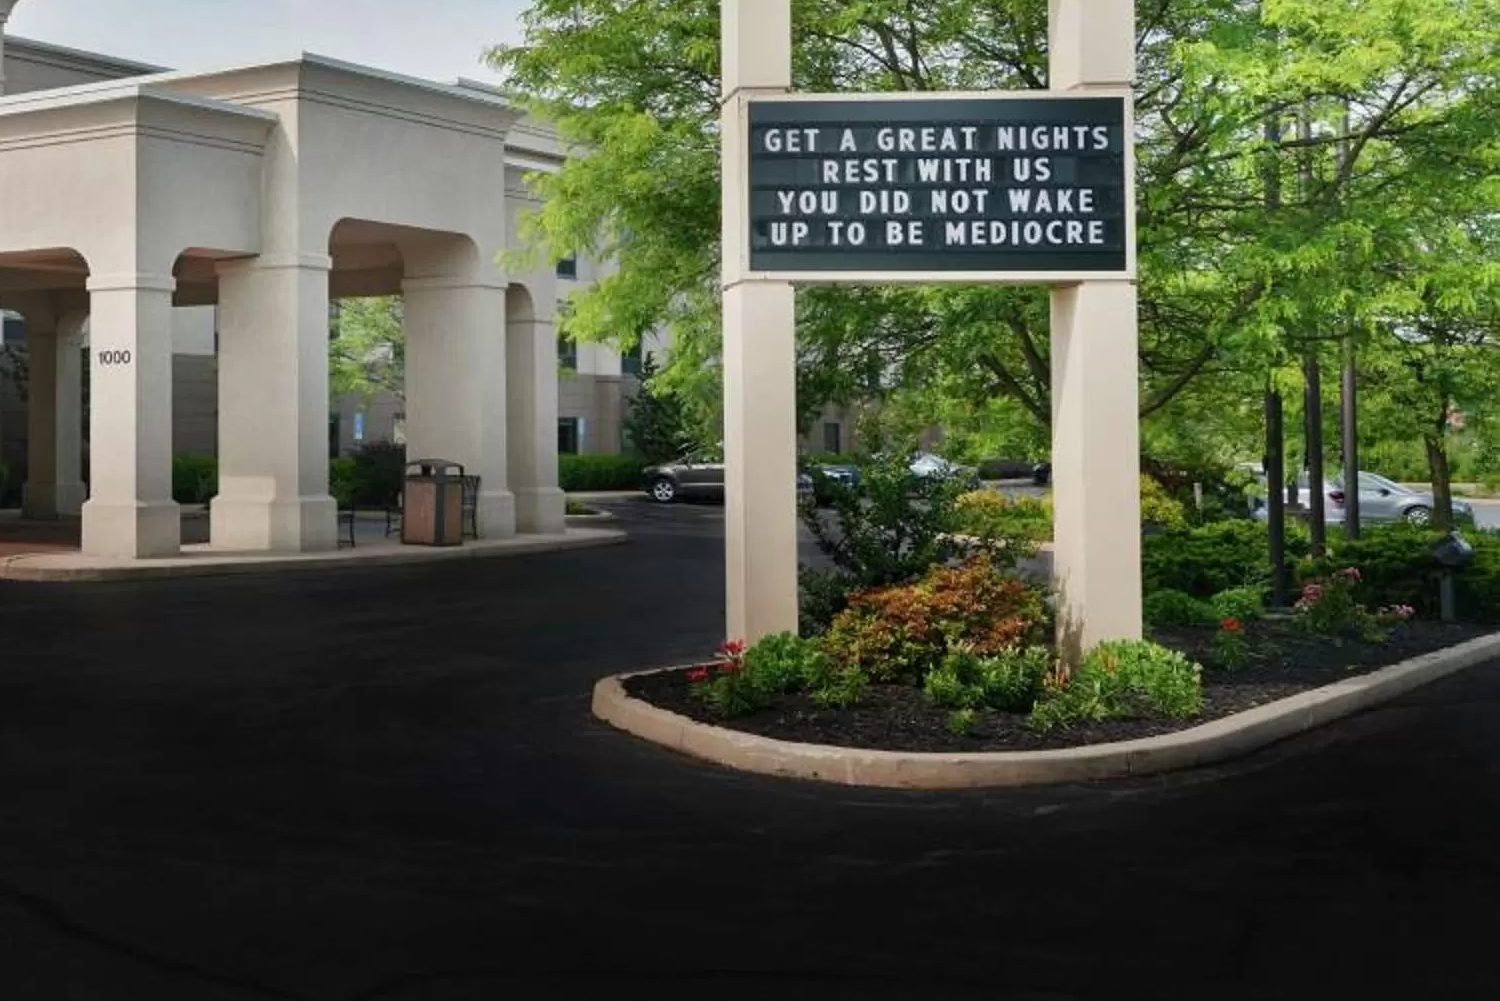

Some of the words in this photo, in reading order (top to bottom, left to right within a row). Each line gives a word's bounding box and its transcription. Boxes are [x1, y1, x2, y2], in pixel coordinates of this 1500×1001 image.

[764, 128, 820, 152] GET
[839, 128, 857, 152] A
[877, 127, 977, 152] GREAT
[998, 126, 1109, 150] NIGHTS
[823, 159, 898, 184] REST
[917, 158, 991, 182] WITH
[1013, 157, 1051, 182] US
[777, 190, 838, 215] YOU
[859, 190, 910, 214] DID
[931, 189, 989, 214] NOT
[1008, 188, 1093, 213] WAKE
[771, 222, 809, 246] UP
[827, 221, 866, 246] TO
[886, 221, 923, 245] BE
[945, 220, 1104, 245] MEDIOCRE
[99, 350, 131, 365] 1000
